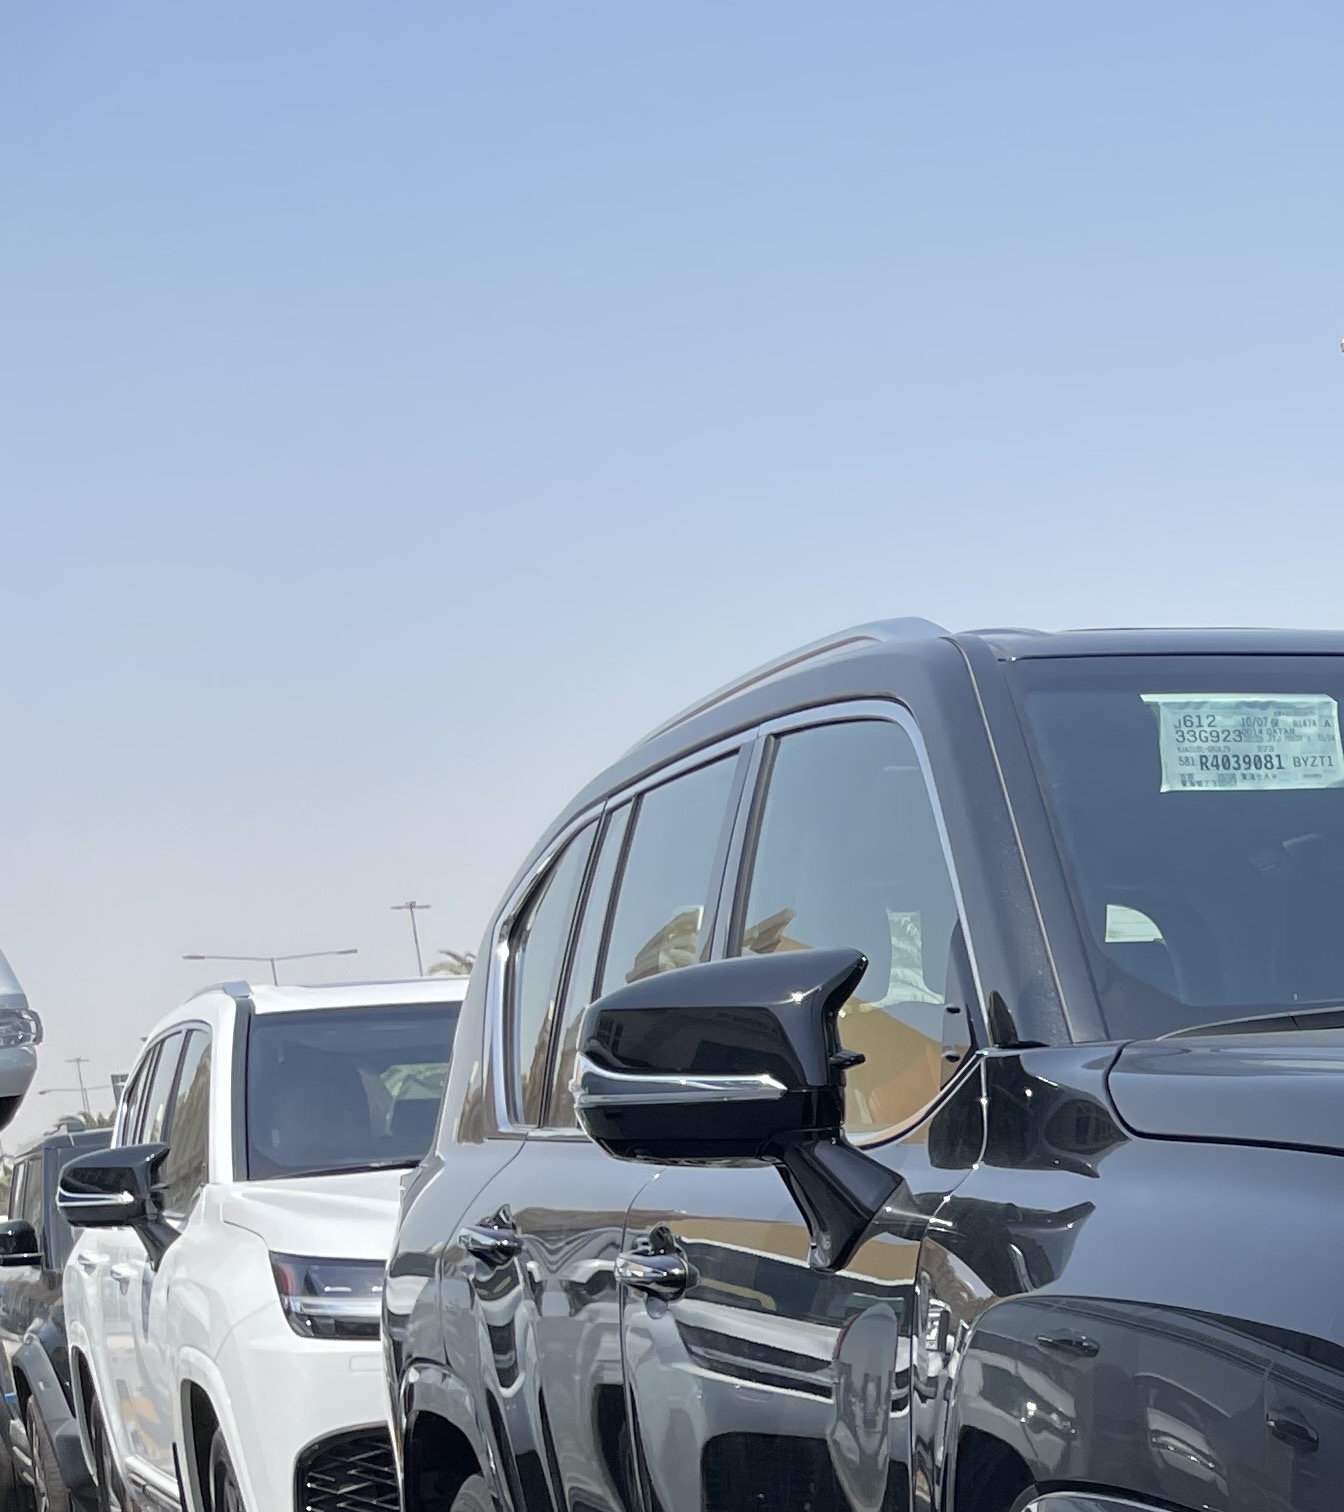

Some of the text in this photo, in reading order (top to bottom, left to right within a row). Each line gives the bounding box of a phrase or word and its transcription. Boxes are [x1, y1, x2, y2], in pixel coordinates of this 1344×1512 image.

[1175, 729, 1242, 744] 33G923
[1200, 754, 1285, 771] R4039081
[1293, 755, 1334, 768] BYZT1
